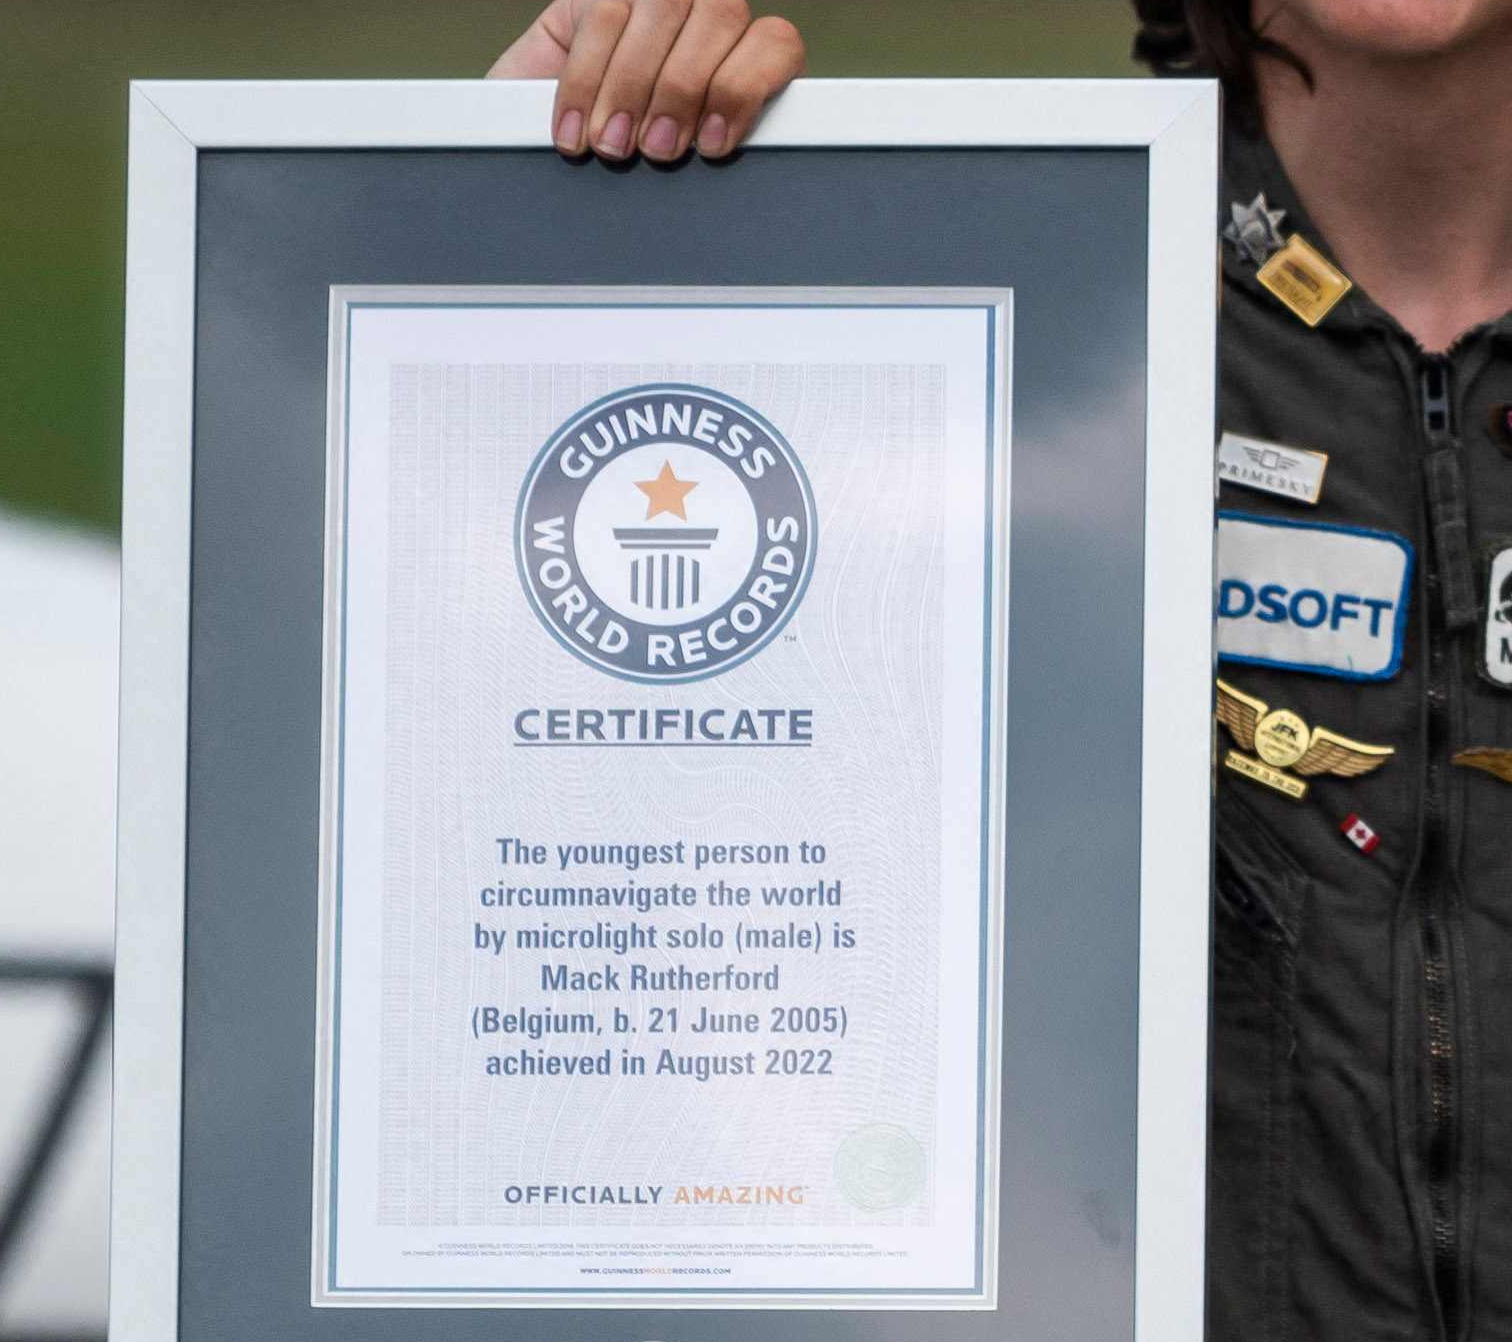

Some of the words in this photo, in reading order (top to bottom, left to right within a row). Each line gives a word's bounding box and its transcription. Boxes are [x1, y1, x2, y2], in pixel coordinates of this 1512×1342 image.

[560, 403, 776, 479] GUINNESS
[534, 515, 629, 654] WORLD
[647, 515, 799, 667] RECORDS
[514, 709, 812, 741] CERTIFICATE
[496, 838, 547, 865] The
[557, 838, 685, 870] youngest
[695, 843, 789, 869] person
[800, 840, 826, 865] to
[480, 880, 697, 912] circumnavigate
[707, 880, 751, 907] the
[760, 880, 842, 907] world
[475, 923, 506, 955] by
[516, 923, 657, 955] microlight
[667, 923, 724, 949] solo
[735, 923, 822, 953] (male)
[832, 923, 856, 949] is
[541, 965, 620, 991] Mack
[631, 965, 779, 991] Rutherford
[472, 1006, 602, 1039] (Belgium,
[613, 1007, 637, 1033] b.
[649, 1007, 680, 1033] 21
[691, 1007, 759, 1033] June
[770, 1006, 848, 1038] 2005)
[486, 1049, 611, 1076] achieved
[621, 1049, 646, 1076] in
[656, 1049, 755, 1081] August
[765, 1049, 832, 1076] 2022
[504, 1186, 663, 1204] OFFICIALLY
[674, 1186, 805, 1204] AMAZING
